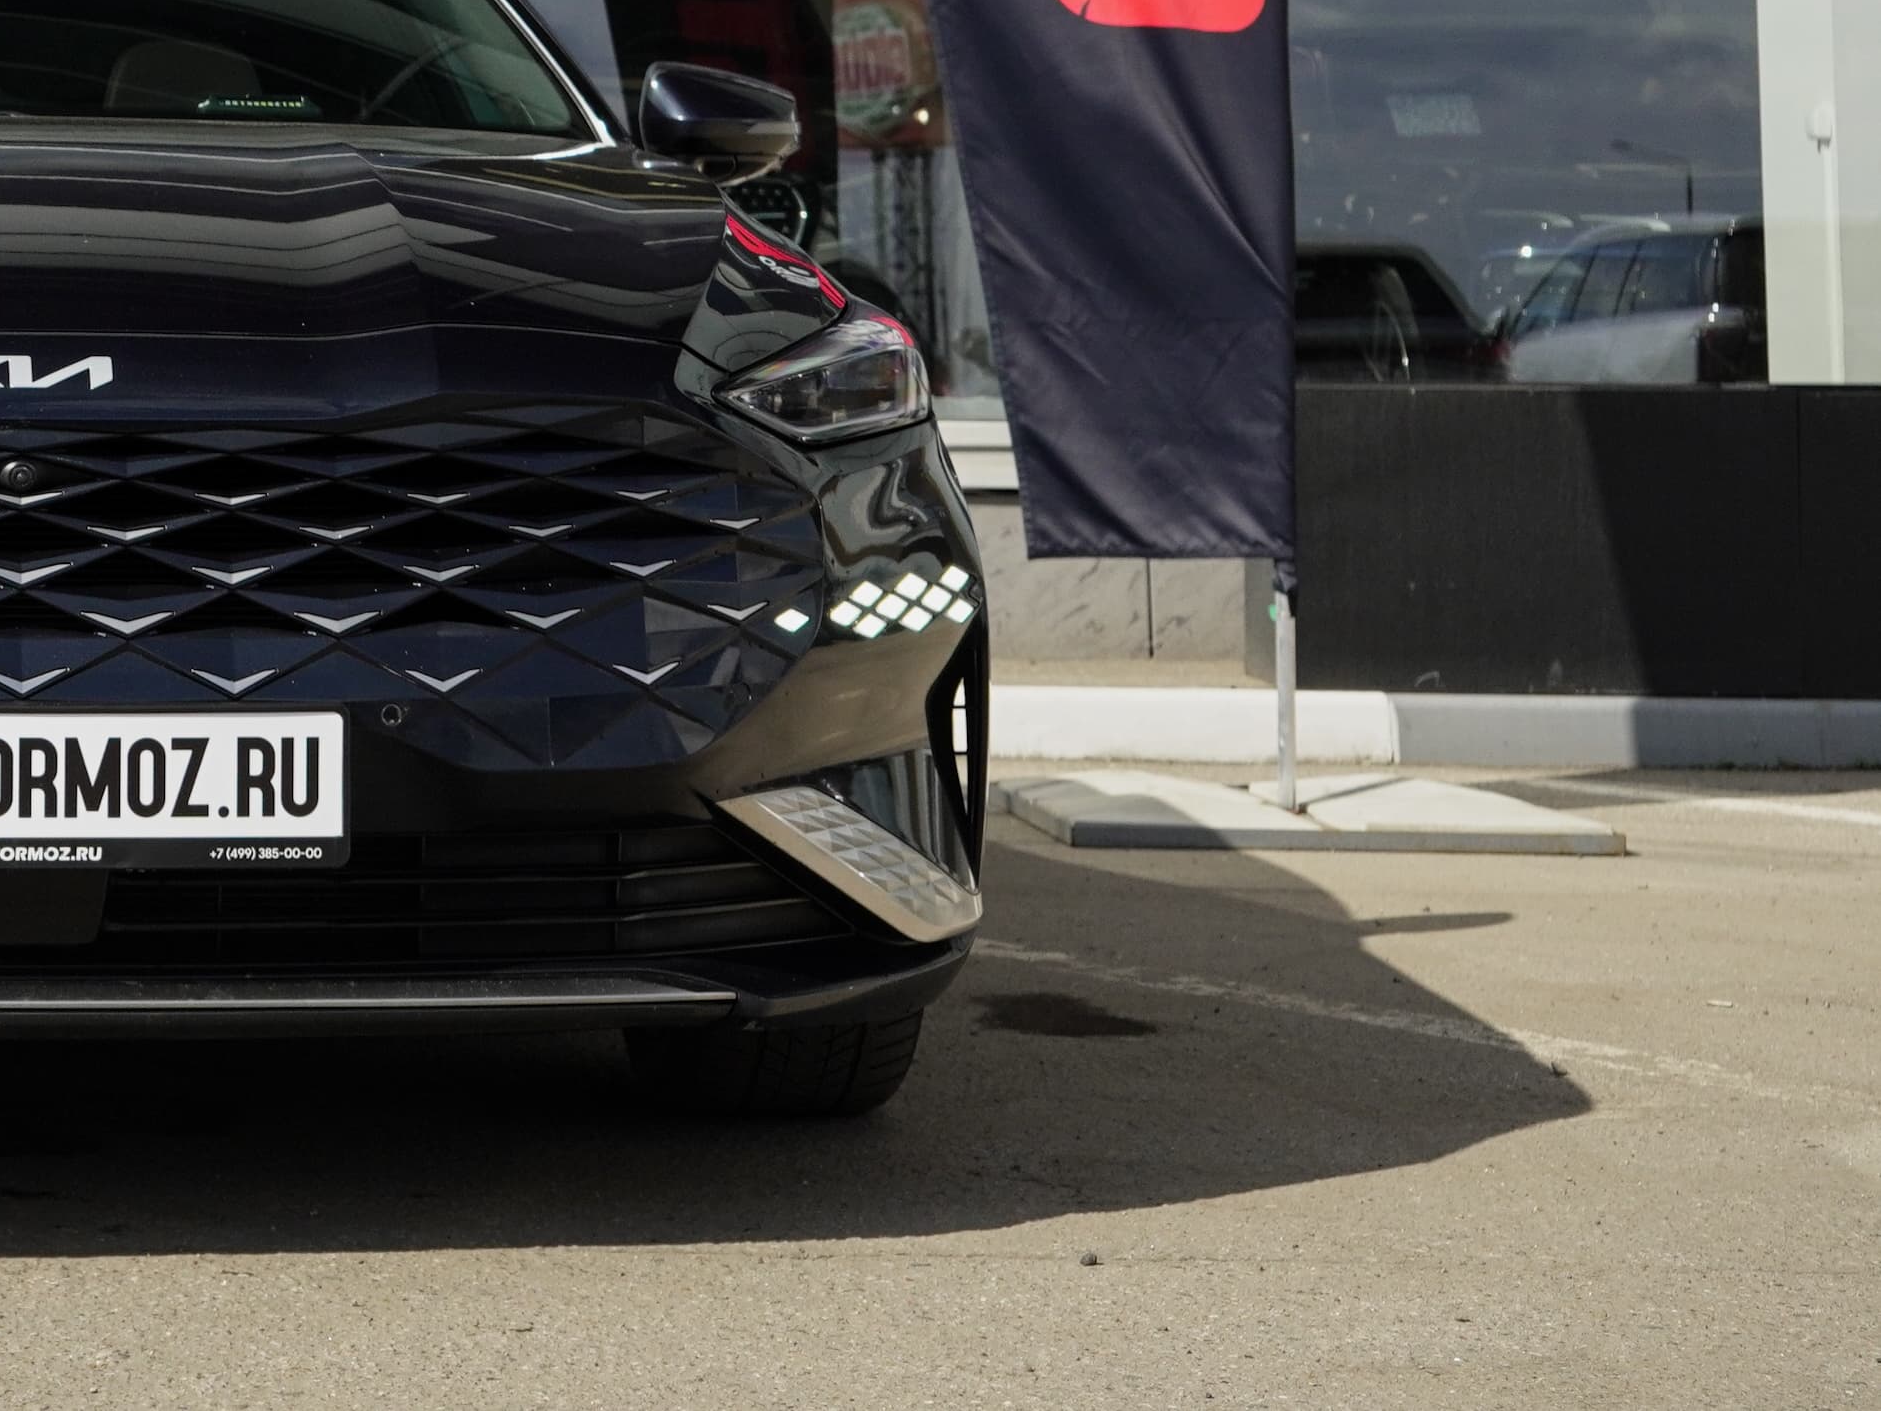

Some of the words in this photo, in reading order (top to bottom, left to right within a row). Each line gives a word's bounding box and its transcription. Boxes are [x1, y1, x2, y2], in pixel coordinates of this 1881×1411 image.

[209, 848, 224, 860] +7
[226, 847, 256, 861] (499)
[258, 847, 322, 860] 385-00-00
